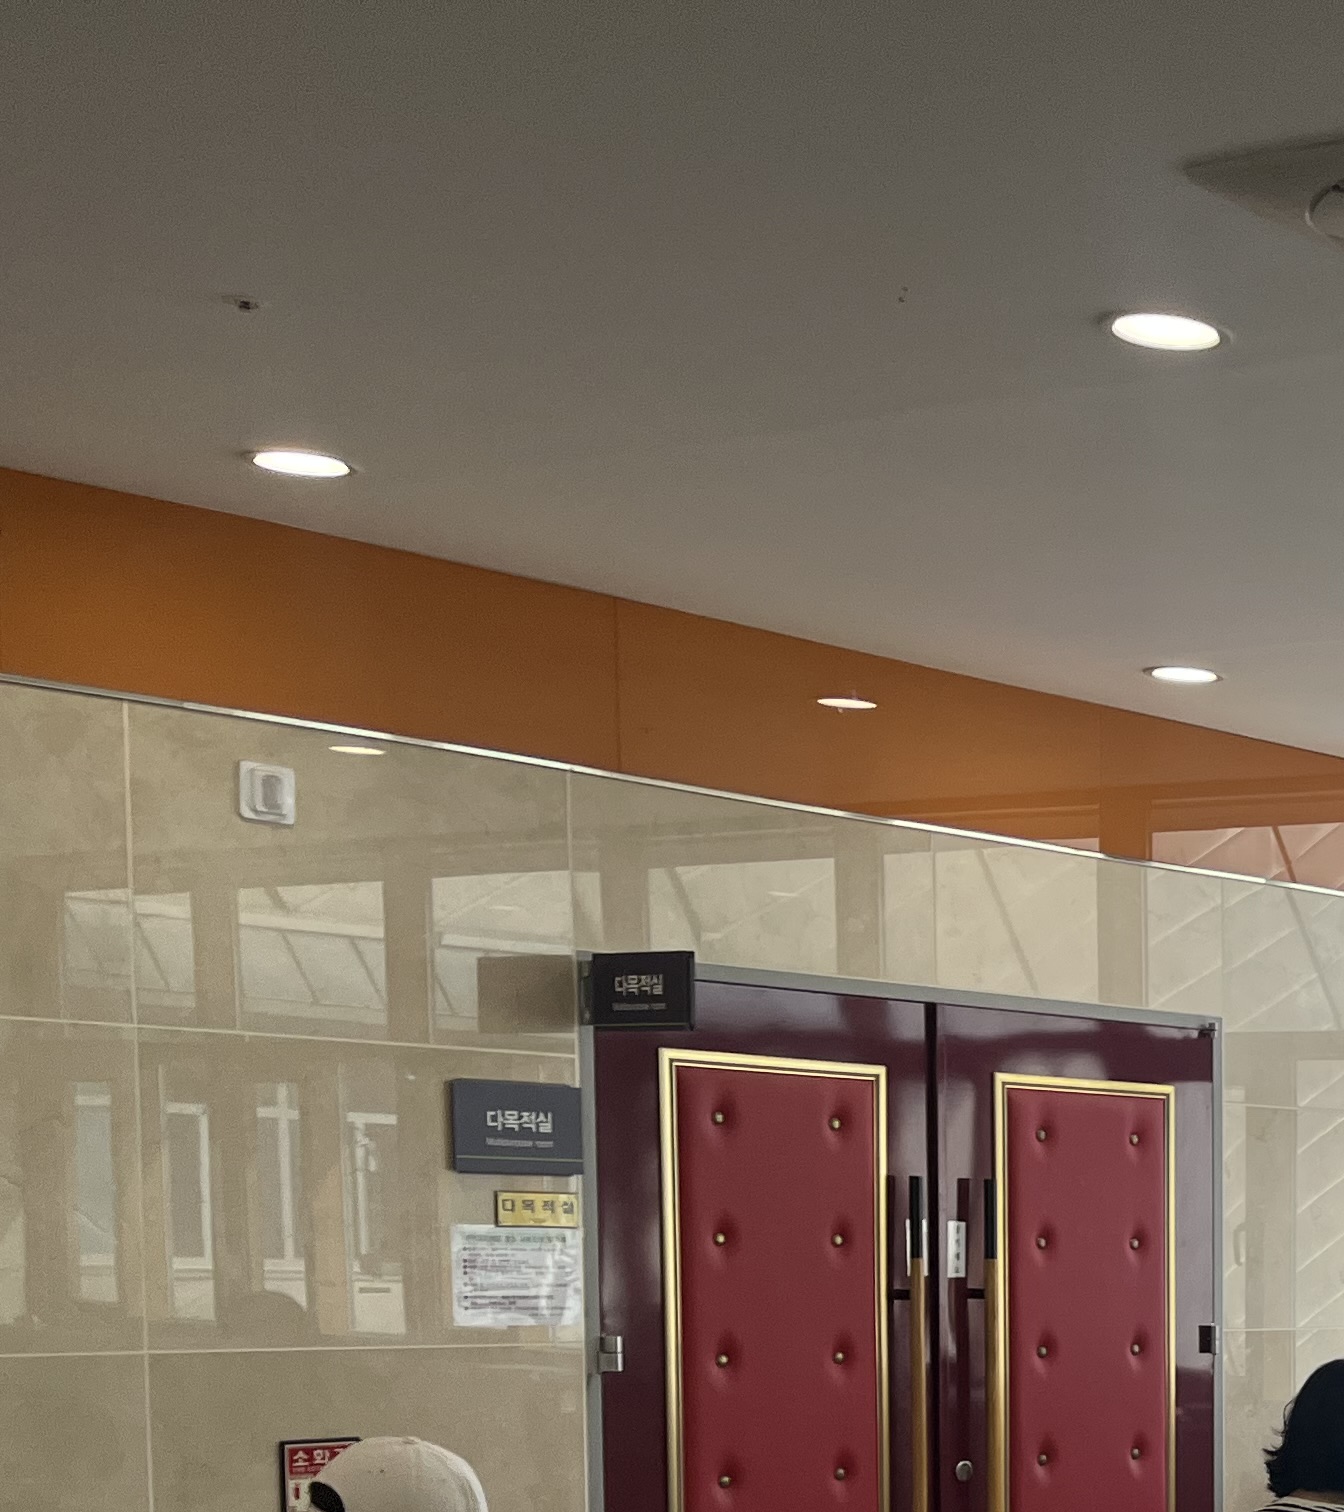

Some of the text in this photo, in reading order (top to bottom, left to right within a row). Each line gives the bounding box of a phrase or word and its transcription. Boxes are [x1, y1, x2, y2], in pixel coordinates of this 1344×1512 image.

[614, 973, 664, 996] 다목적실
[486, 1109, 554, 1133] 다목적실
[292, 1447, 346, 1467] 소화
